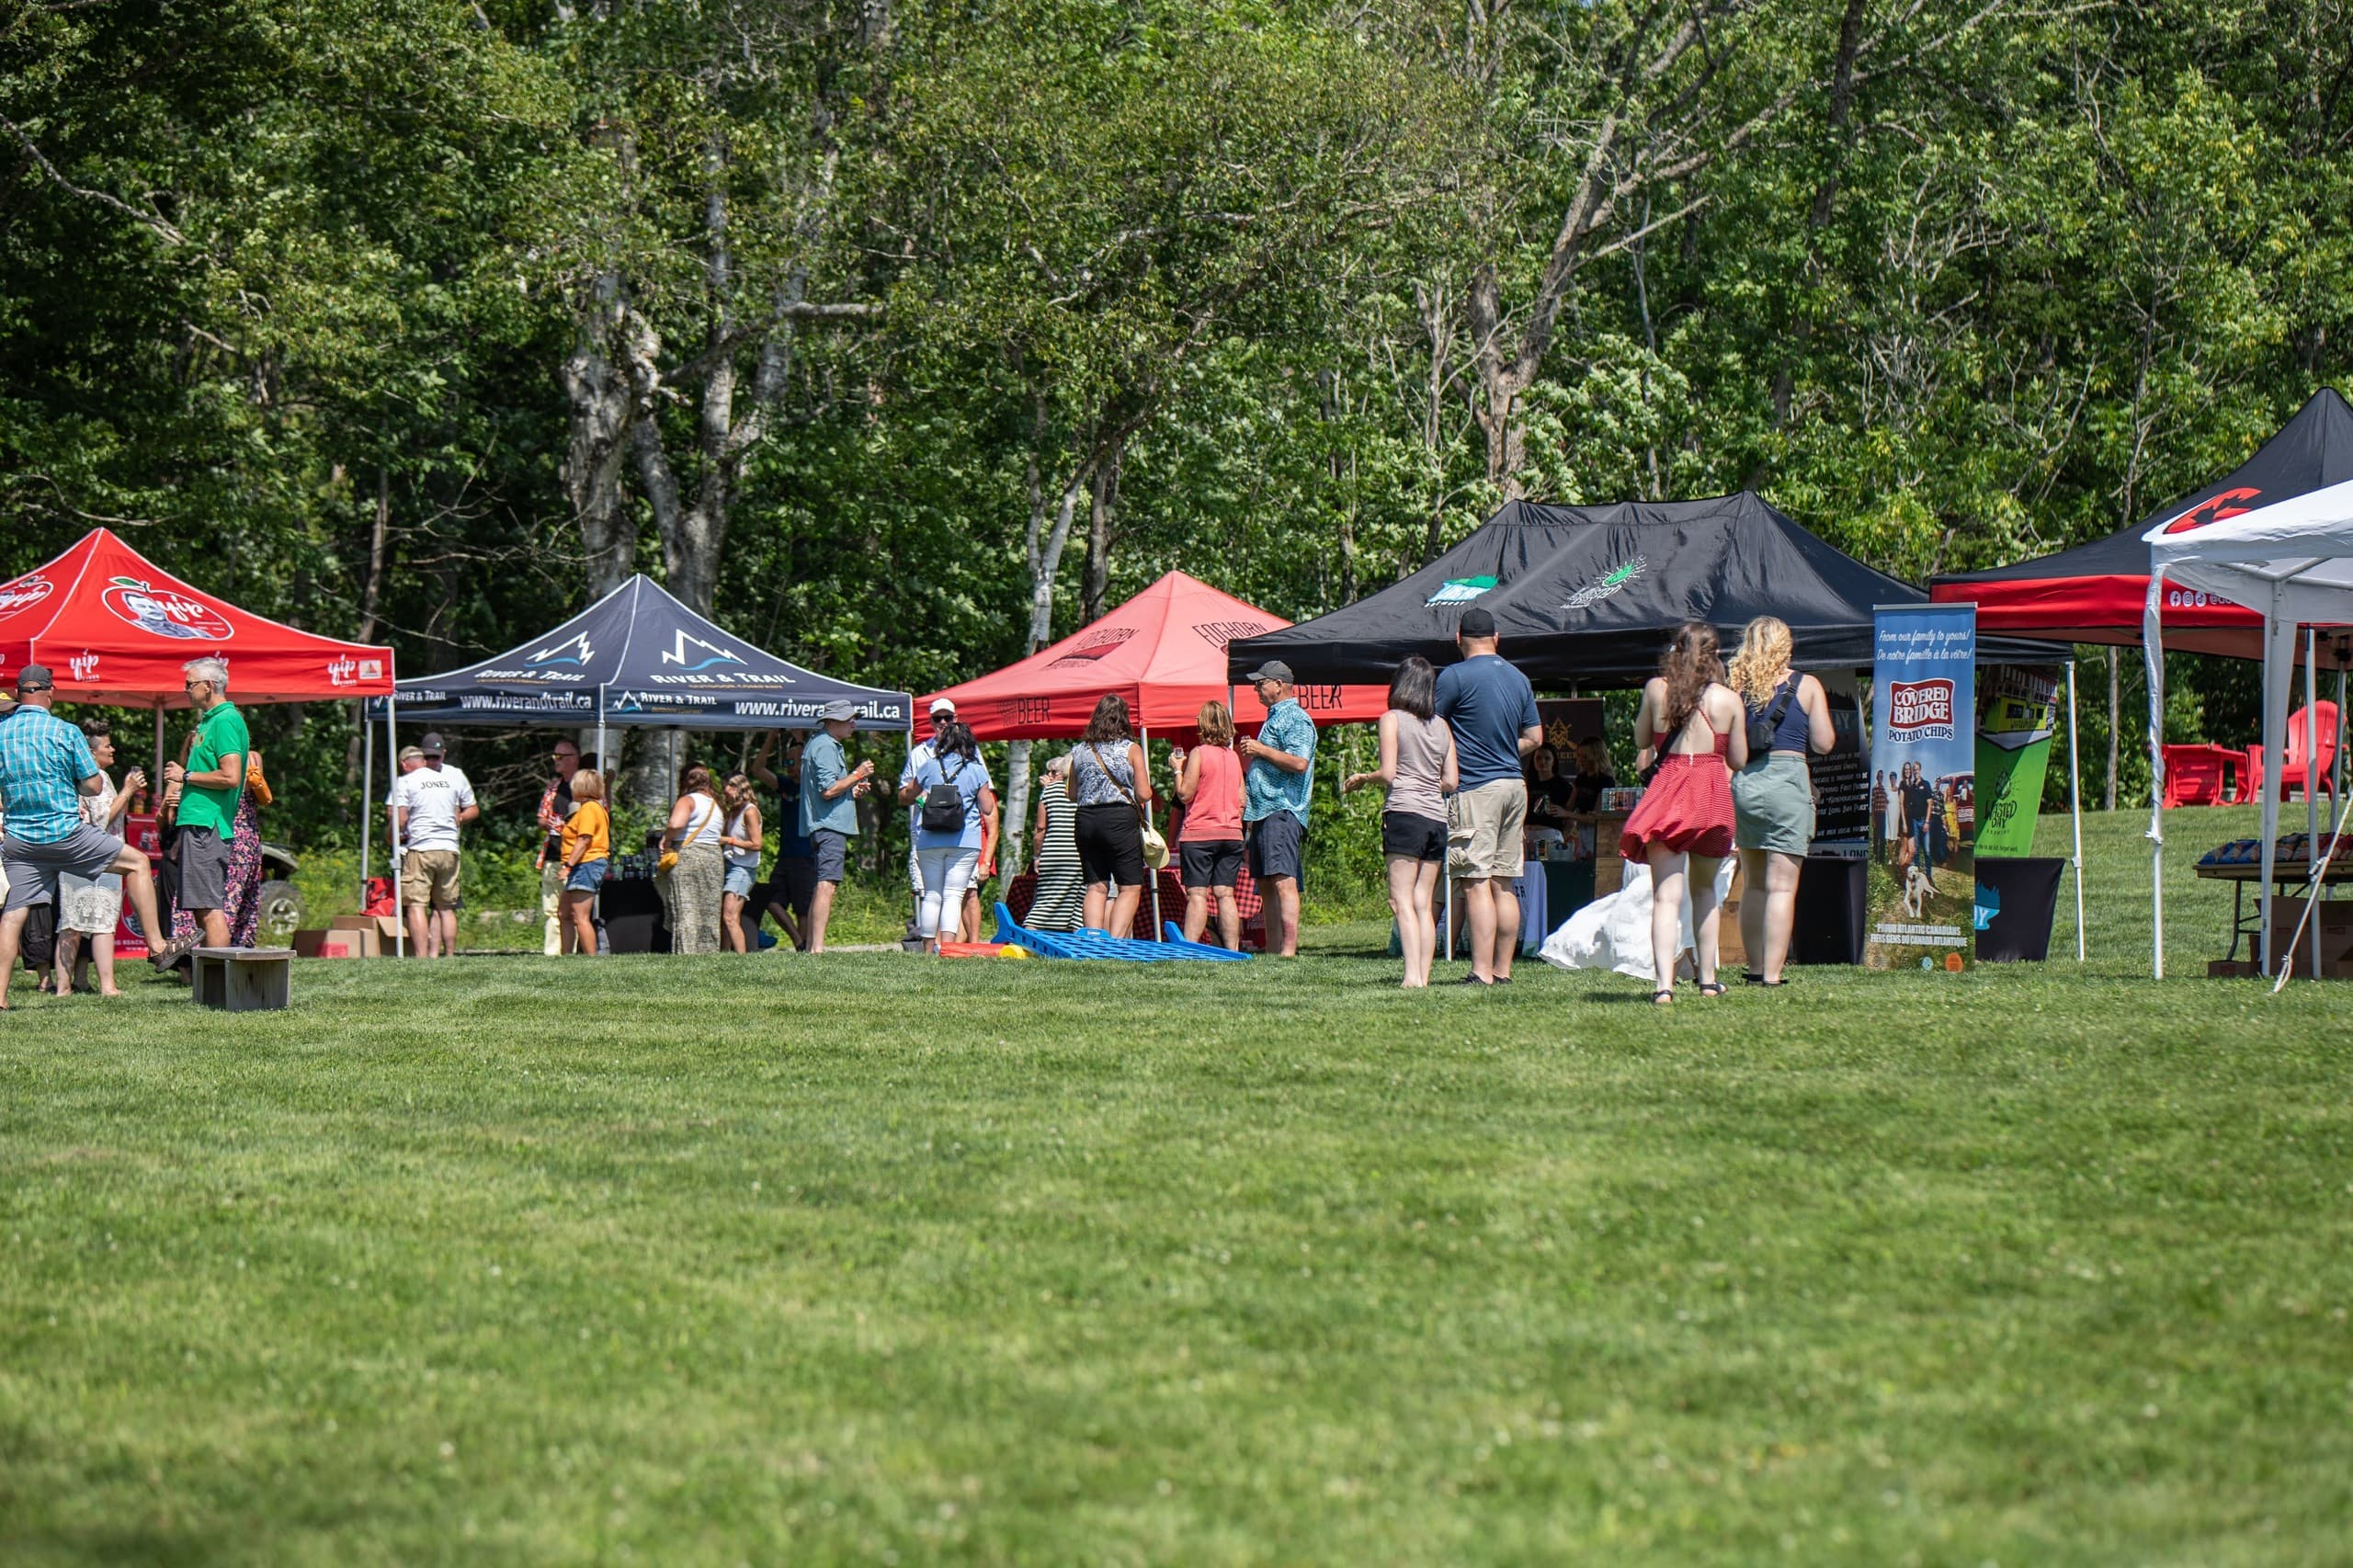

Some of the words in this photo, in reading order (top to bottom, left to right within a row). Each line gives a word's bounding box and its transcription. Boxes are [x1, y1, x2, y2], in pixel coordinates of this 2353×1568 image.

[156, 594, 204, 621] yip
[1192, 621, 1268, 649] FOGHORN
[1879, 630, 1897, 642] From
[1898, 633, 1911, 642] our
[1911, 629, 1936, 646] family
[1937, 630, 1944, 641] to
[1945, 629, 1972, 646] yours!
[70, 648, 99, 681] yip
[1877, 649, 1885, 661] De
[1886, 651, 1905, 660] notre
[1905, 648, 1932, 665] famille
[1940, 648, 1949, 660] la
[327, 653, 356, 686] yip
[716, 674, 735, 683] &
[460, 691, 592, 710] www.riverandtrail.ca
[676, 695, 685, 704] &
[1298, 684, 1343, 710] BEER
[1894, 687, 1949, 706] COVERED
[735, 699, 900, 719] www.riverarail.ca
[1017, 697, 1051, 724] BEER
[1893, 701, 1949, 723] BRIDGE
[1889, 729, 1923, 743] POTATO
[1924, 726, 1953, 739] CHIPS
[420, 780, 450, 790] JONES
